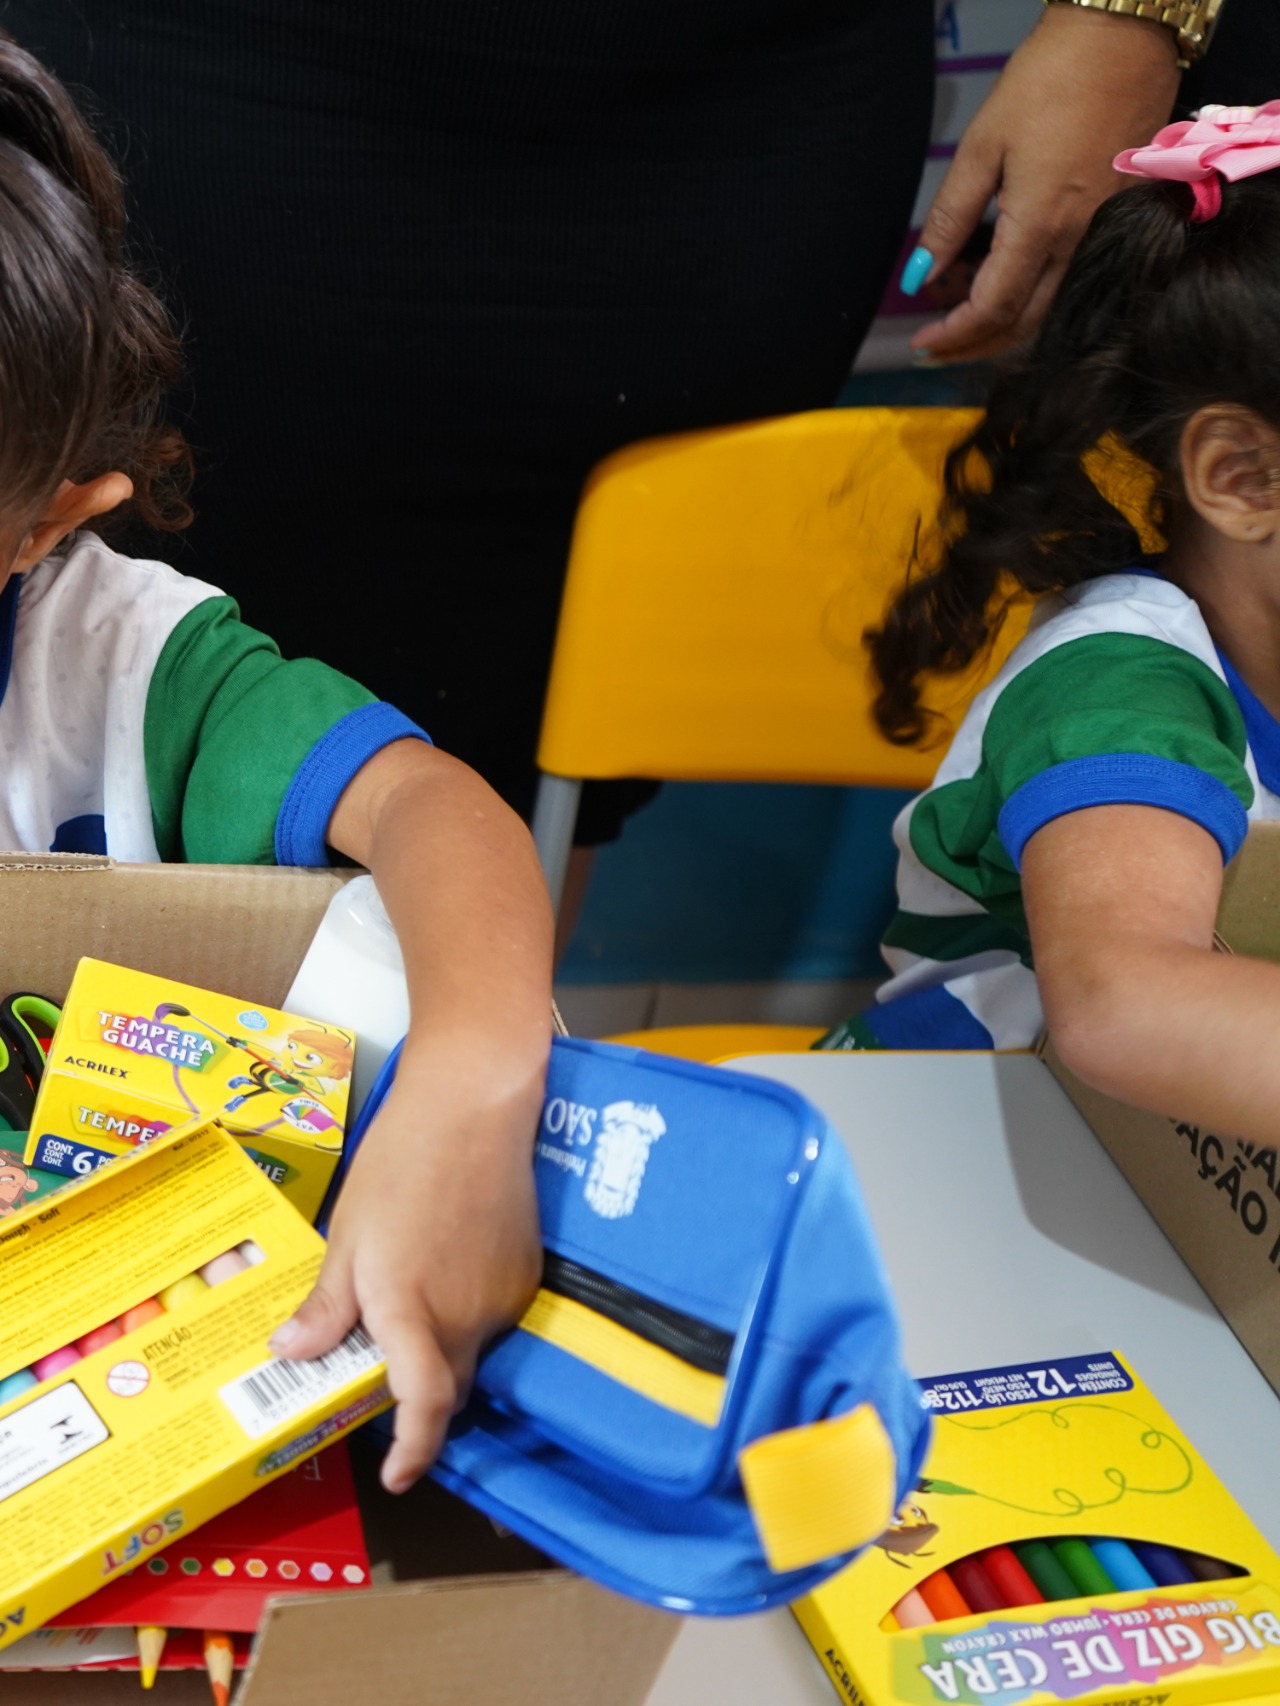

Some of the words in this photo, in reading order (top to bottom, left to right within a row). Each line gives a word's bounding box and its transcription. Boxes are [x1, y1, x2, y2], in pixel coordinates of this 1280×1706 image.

[97, 1010, 216, 1056] TEMPERA
[103, 1028, 204, 1067] GUACHE
[64, 1056, 129, 1080] ACRILEX
[78, 1106, 165, 1145] TEMPE
[545, 1097, 598, 1147] SÃO
[44, 1148, 64, 1160] CONT.
[46, 1138, 74, 1156] CONT.
[42, 1154, 62, 1168] CONT.
[72, 1150, 94, 1174] 6
[1175, 1122, 1268, 1236] AÇÃO
[37, 1206, 61, 1224] Soft
[142, 1326, 192, 1362] ATENÇÃO
[1006, 1372, 1024, 1382] NET
[1074, 1370, 1120, 1382] UNIDADES
[1087, 1362, 1114, 1372] UNITS
[973, 1375, 1006, 1387] WEIGHT
[981, 1384, 1005, 1394] NETO
[1006, 1380, 1030, 1391] PESO
[1026, 1368, 1077, 1397] 12
[1078, 1378, 1128, 1394] CONTÉM
[1006, 1387, 1037, 1401] PESO
[101, 1508, 184, 1576] SOFT
[1110, 1608, 1151, 1628] CERA
[1148, 1606, 1172, 1620] DE
[1176, 1600, 1238, 1616] CRAYON
[1010, 1624, 1048, 1644] WAX
[1051, 1616, 1104, 1638] JUMBO
[1206, 1611, 1280, 1654] BIG
[942, 1632, 1008, 1654] CRAYON
[1124, 1624, 1204, 1668] GIZ
[1053, 1634, 1125, 1679] DE
[825, 1648, 865, 1706] ACRIL
[920, 1648, 1048, 1700] CERA
